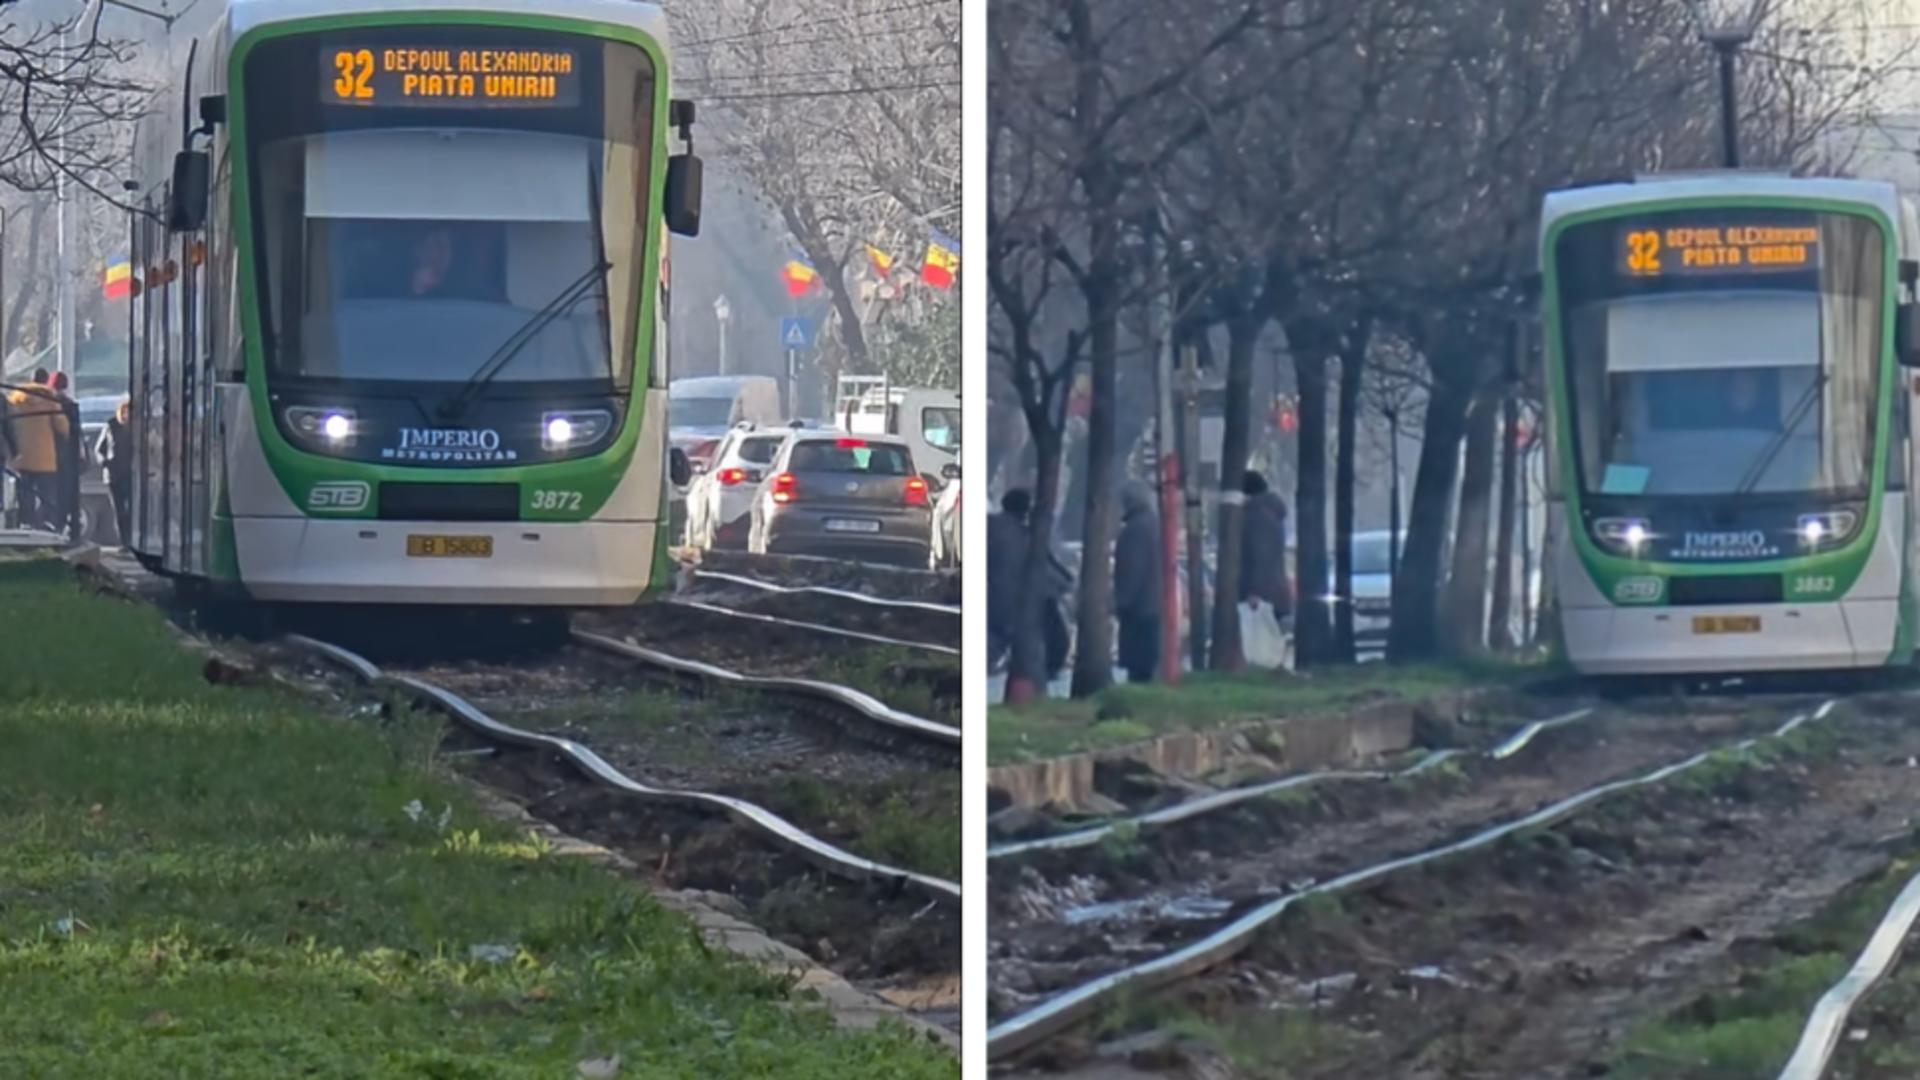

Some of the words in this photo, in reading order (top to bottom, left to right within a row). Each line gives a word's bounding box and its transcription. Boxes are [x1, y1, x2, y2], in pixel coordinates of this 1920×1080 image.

[384, 50, 452, 71] DEPOUL
[459, 51, 571, 73] ALEXANDRIA
[334, 50, 374, 98] 32
[403, 74, 474, 97] PIATA
[484, 75, 556, 97] UNIRII
[1627, 231, 1660, 271] 32
[400, 428, 500, 449] IMPERIO
[382, 447, 518, 460] METROPOLITAN
[308, 485, 364, 506] STB
[531, 489, 584, 511] 3872
